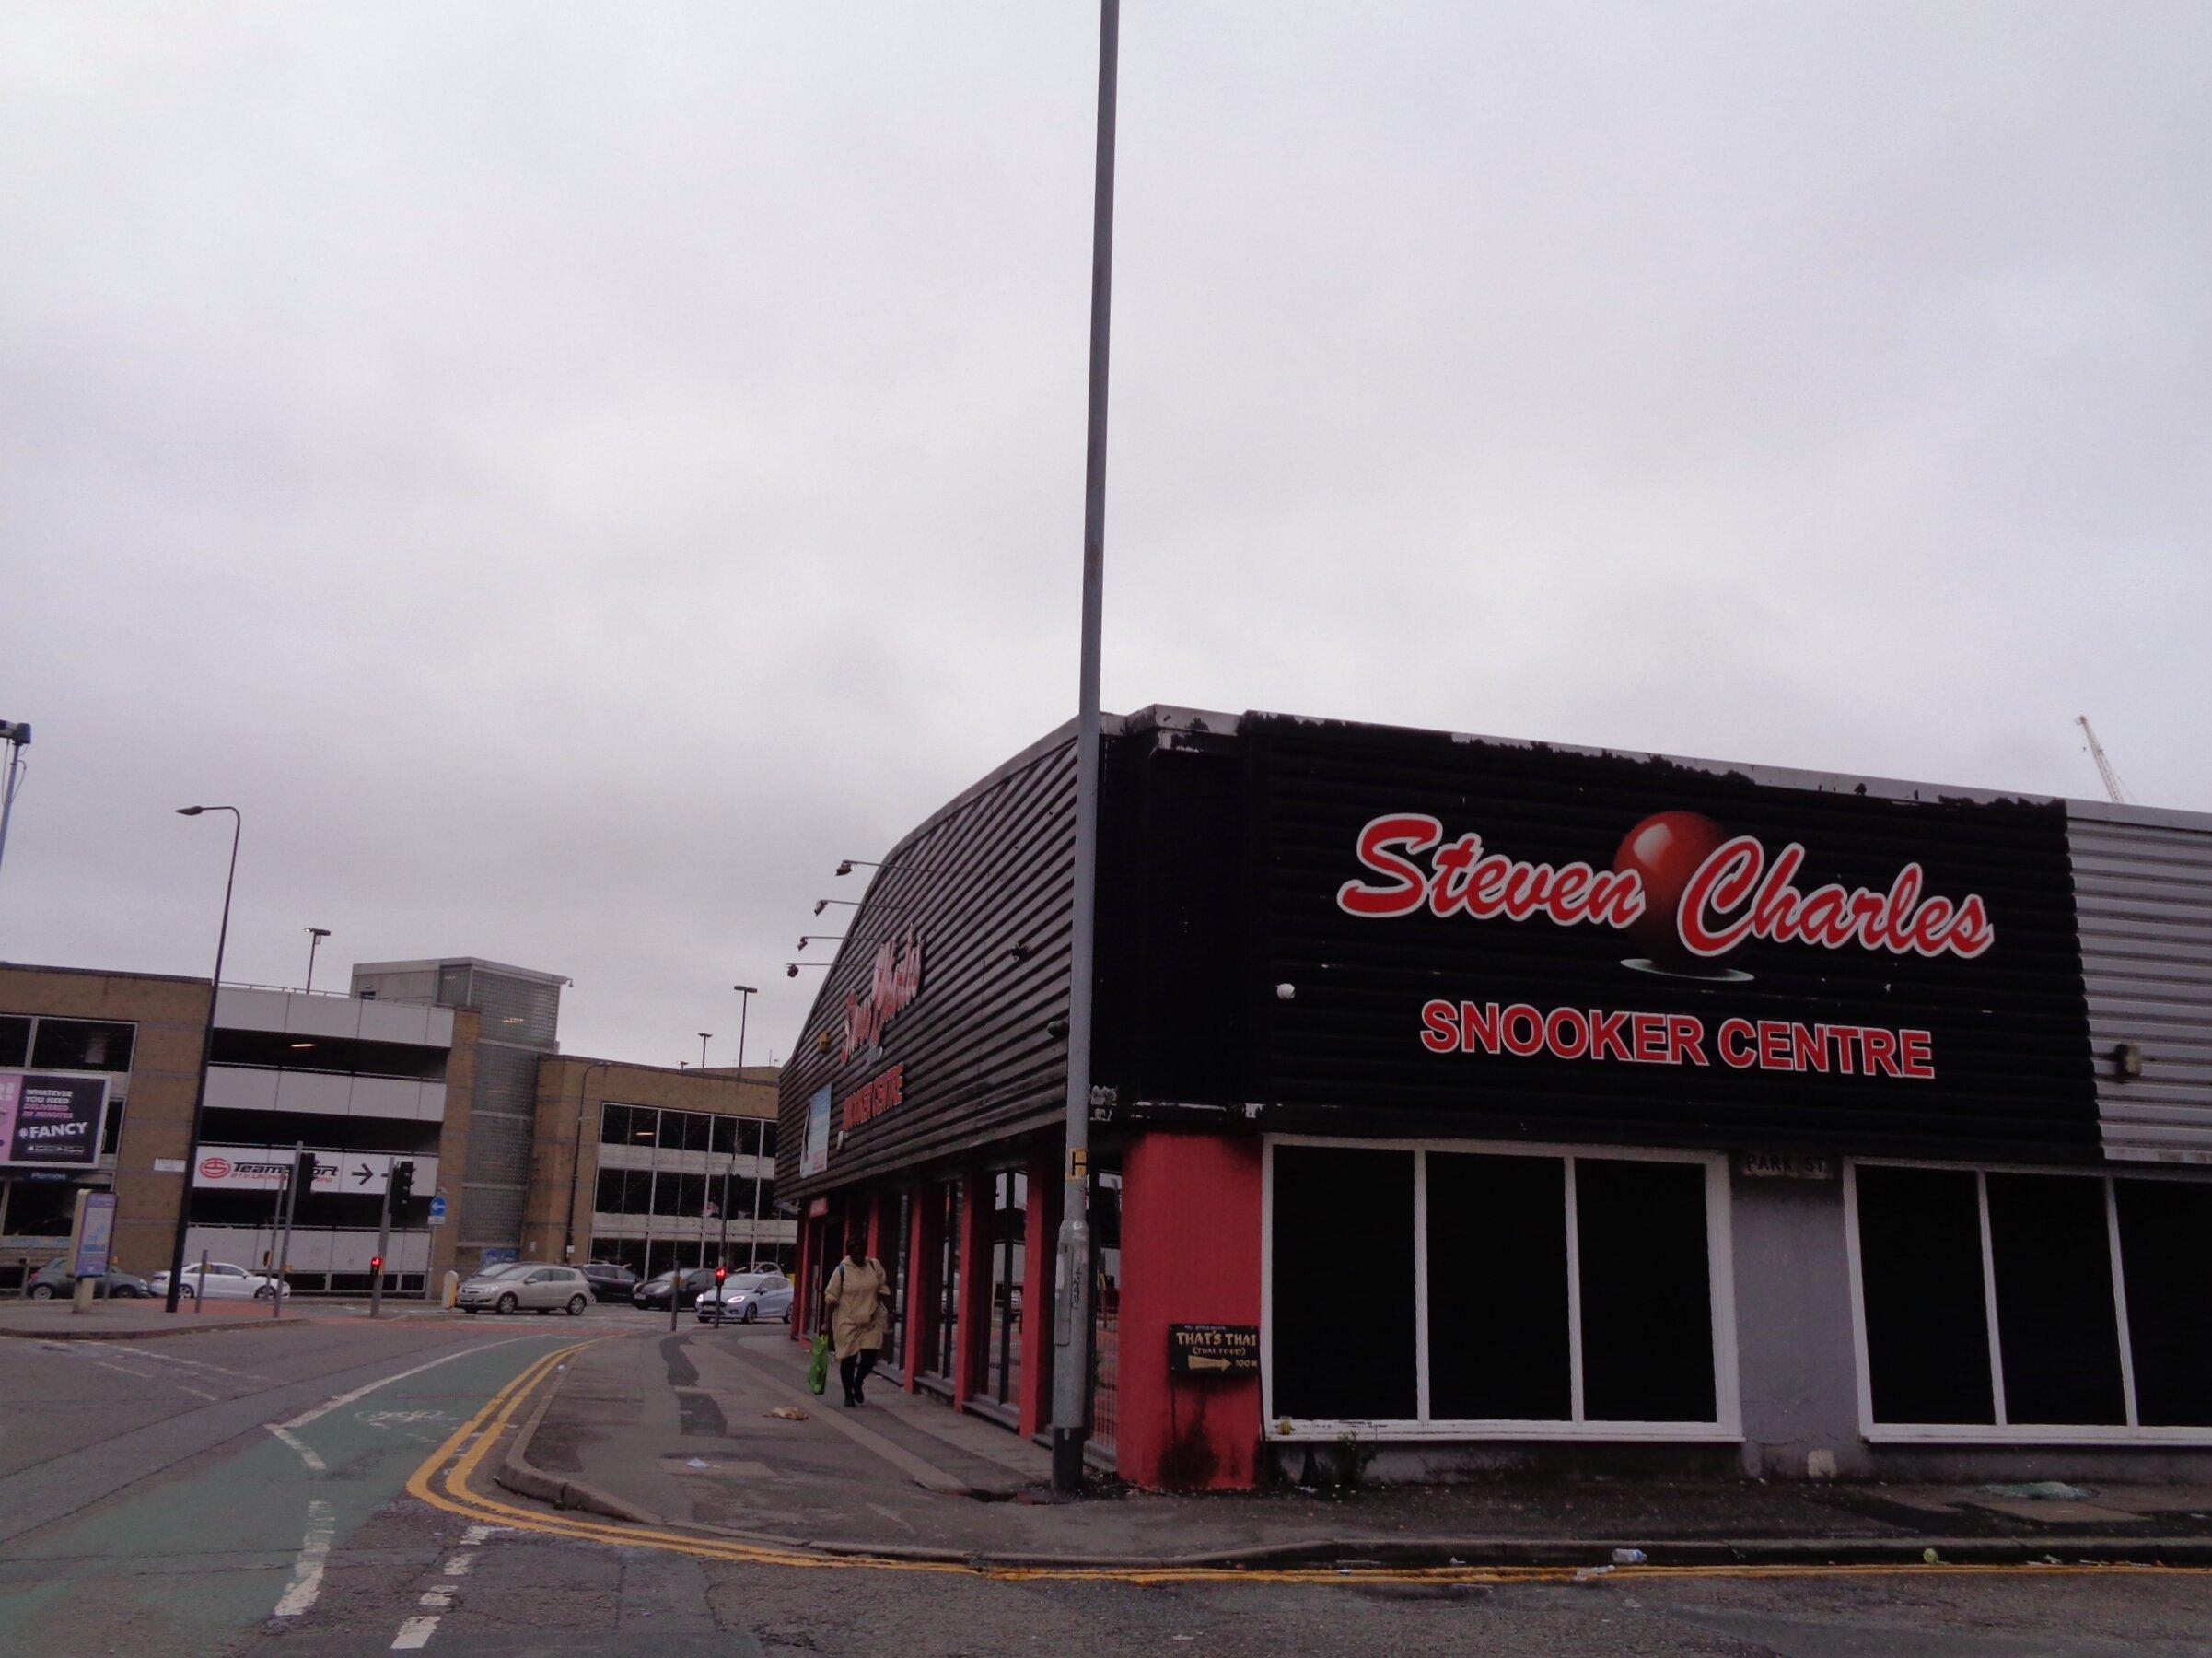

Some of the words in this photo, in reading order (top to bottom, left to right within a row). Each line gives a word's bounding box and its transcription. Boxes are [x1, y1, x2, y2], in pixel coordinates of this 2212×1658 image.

[1336, 813, 1646, 928] Steven
[1677, 835, 1995, 959] Charles
[1420, 999, 1709, 1066] SNOOKER
[1718, 1018, 1935, 1079] CENTRE
[26, 1089, 73, 1097] WHATEVER
[29, 1121, 88, 1138] FANCY
[233, 1162, 339, 1176] Teamort
[1747, 1154, 1794, 1172] PARK
[1176, 1330, 1222, 1345] THAT'S
[1225, 1333, 1257, 1346] THAI
